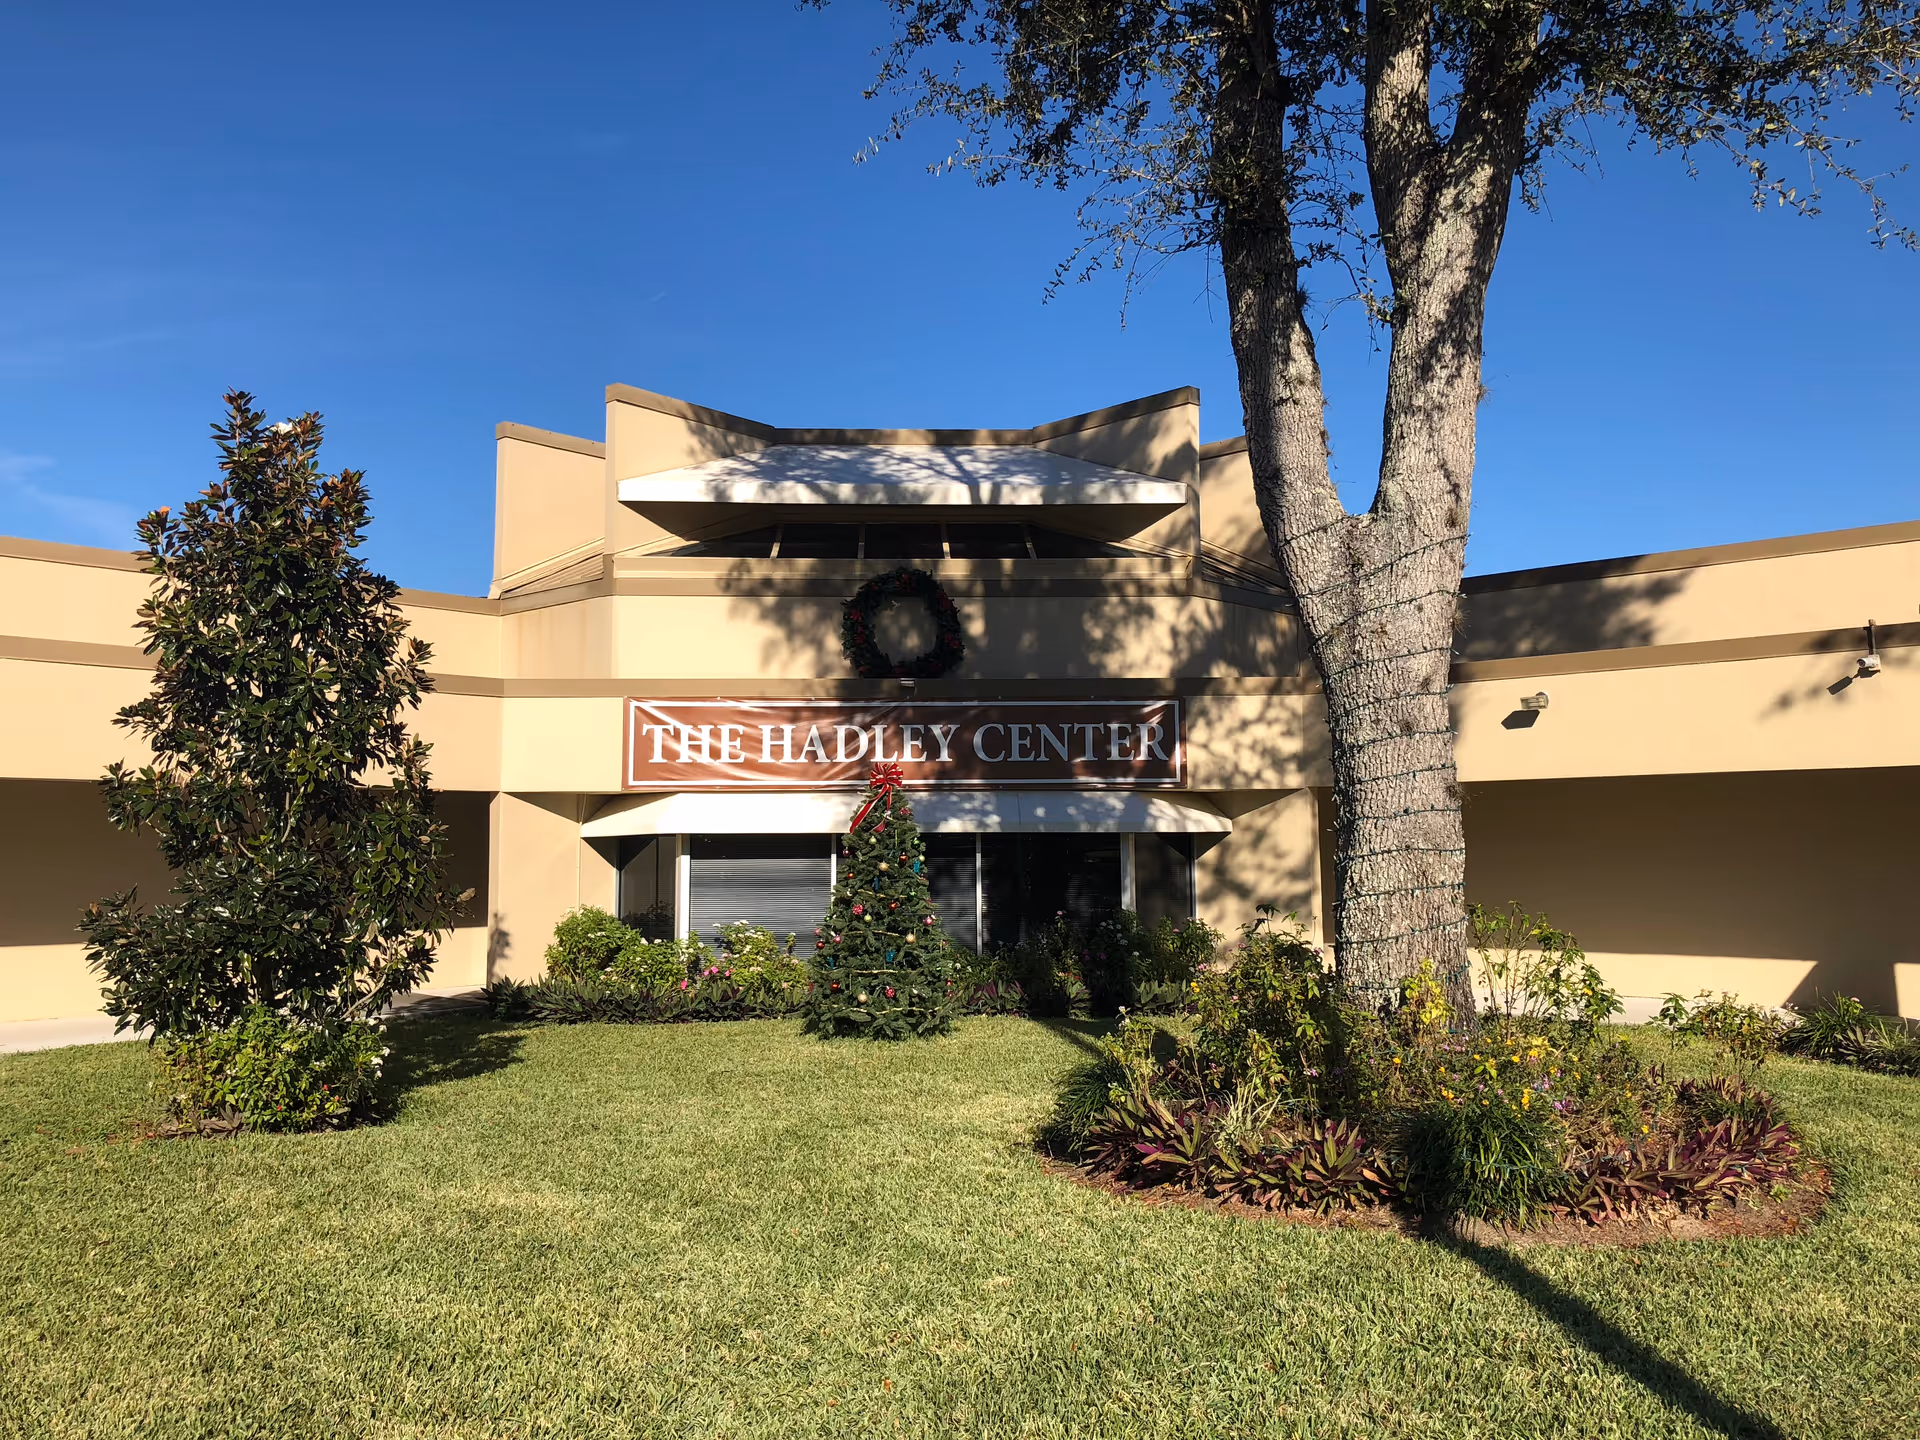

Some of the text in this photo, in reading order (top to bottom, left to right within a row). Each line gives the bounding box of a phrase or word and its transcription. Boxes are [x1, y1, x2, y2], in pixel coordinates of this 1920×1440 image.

[642, 722, 1169, 764] THE HADLEY CENTER
